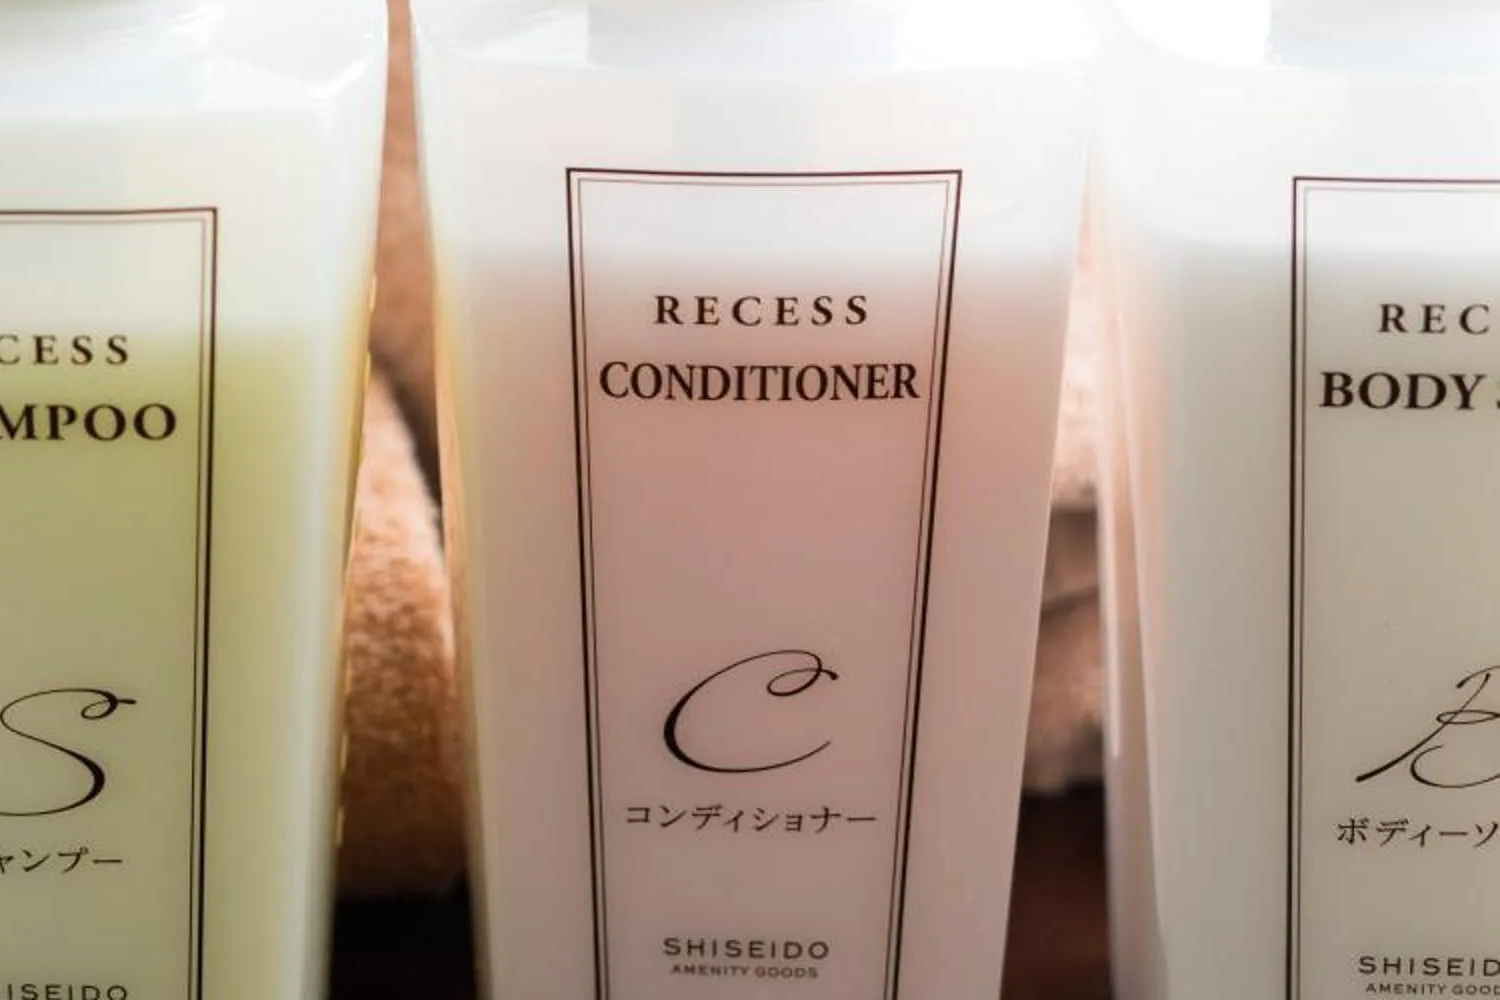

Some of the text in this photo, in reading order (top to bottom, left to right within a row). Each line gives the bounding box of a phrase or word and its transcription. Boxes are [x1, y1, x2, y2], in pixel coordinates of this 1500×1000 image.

[653, 295, 868, 327] RECESS
[599, 361, 921, 401] CONDITIONER
[1318, 370, 1488, 411] BODY
[663, 649, 840, 774] C
[626, 804, 878, 834] コンディショナー
[1336, 816, 1499, 849] ボディーソ
[663, 937, 830, 960] SHISEIDO
[670, 963, 819, 979] AMENITY GOODS
[1358, 955, 1500, 977] SHISEID
[1366, 983, 1447, 996] AMENITY
